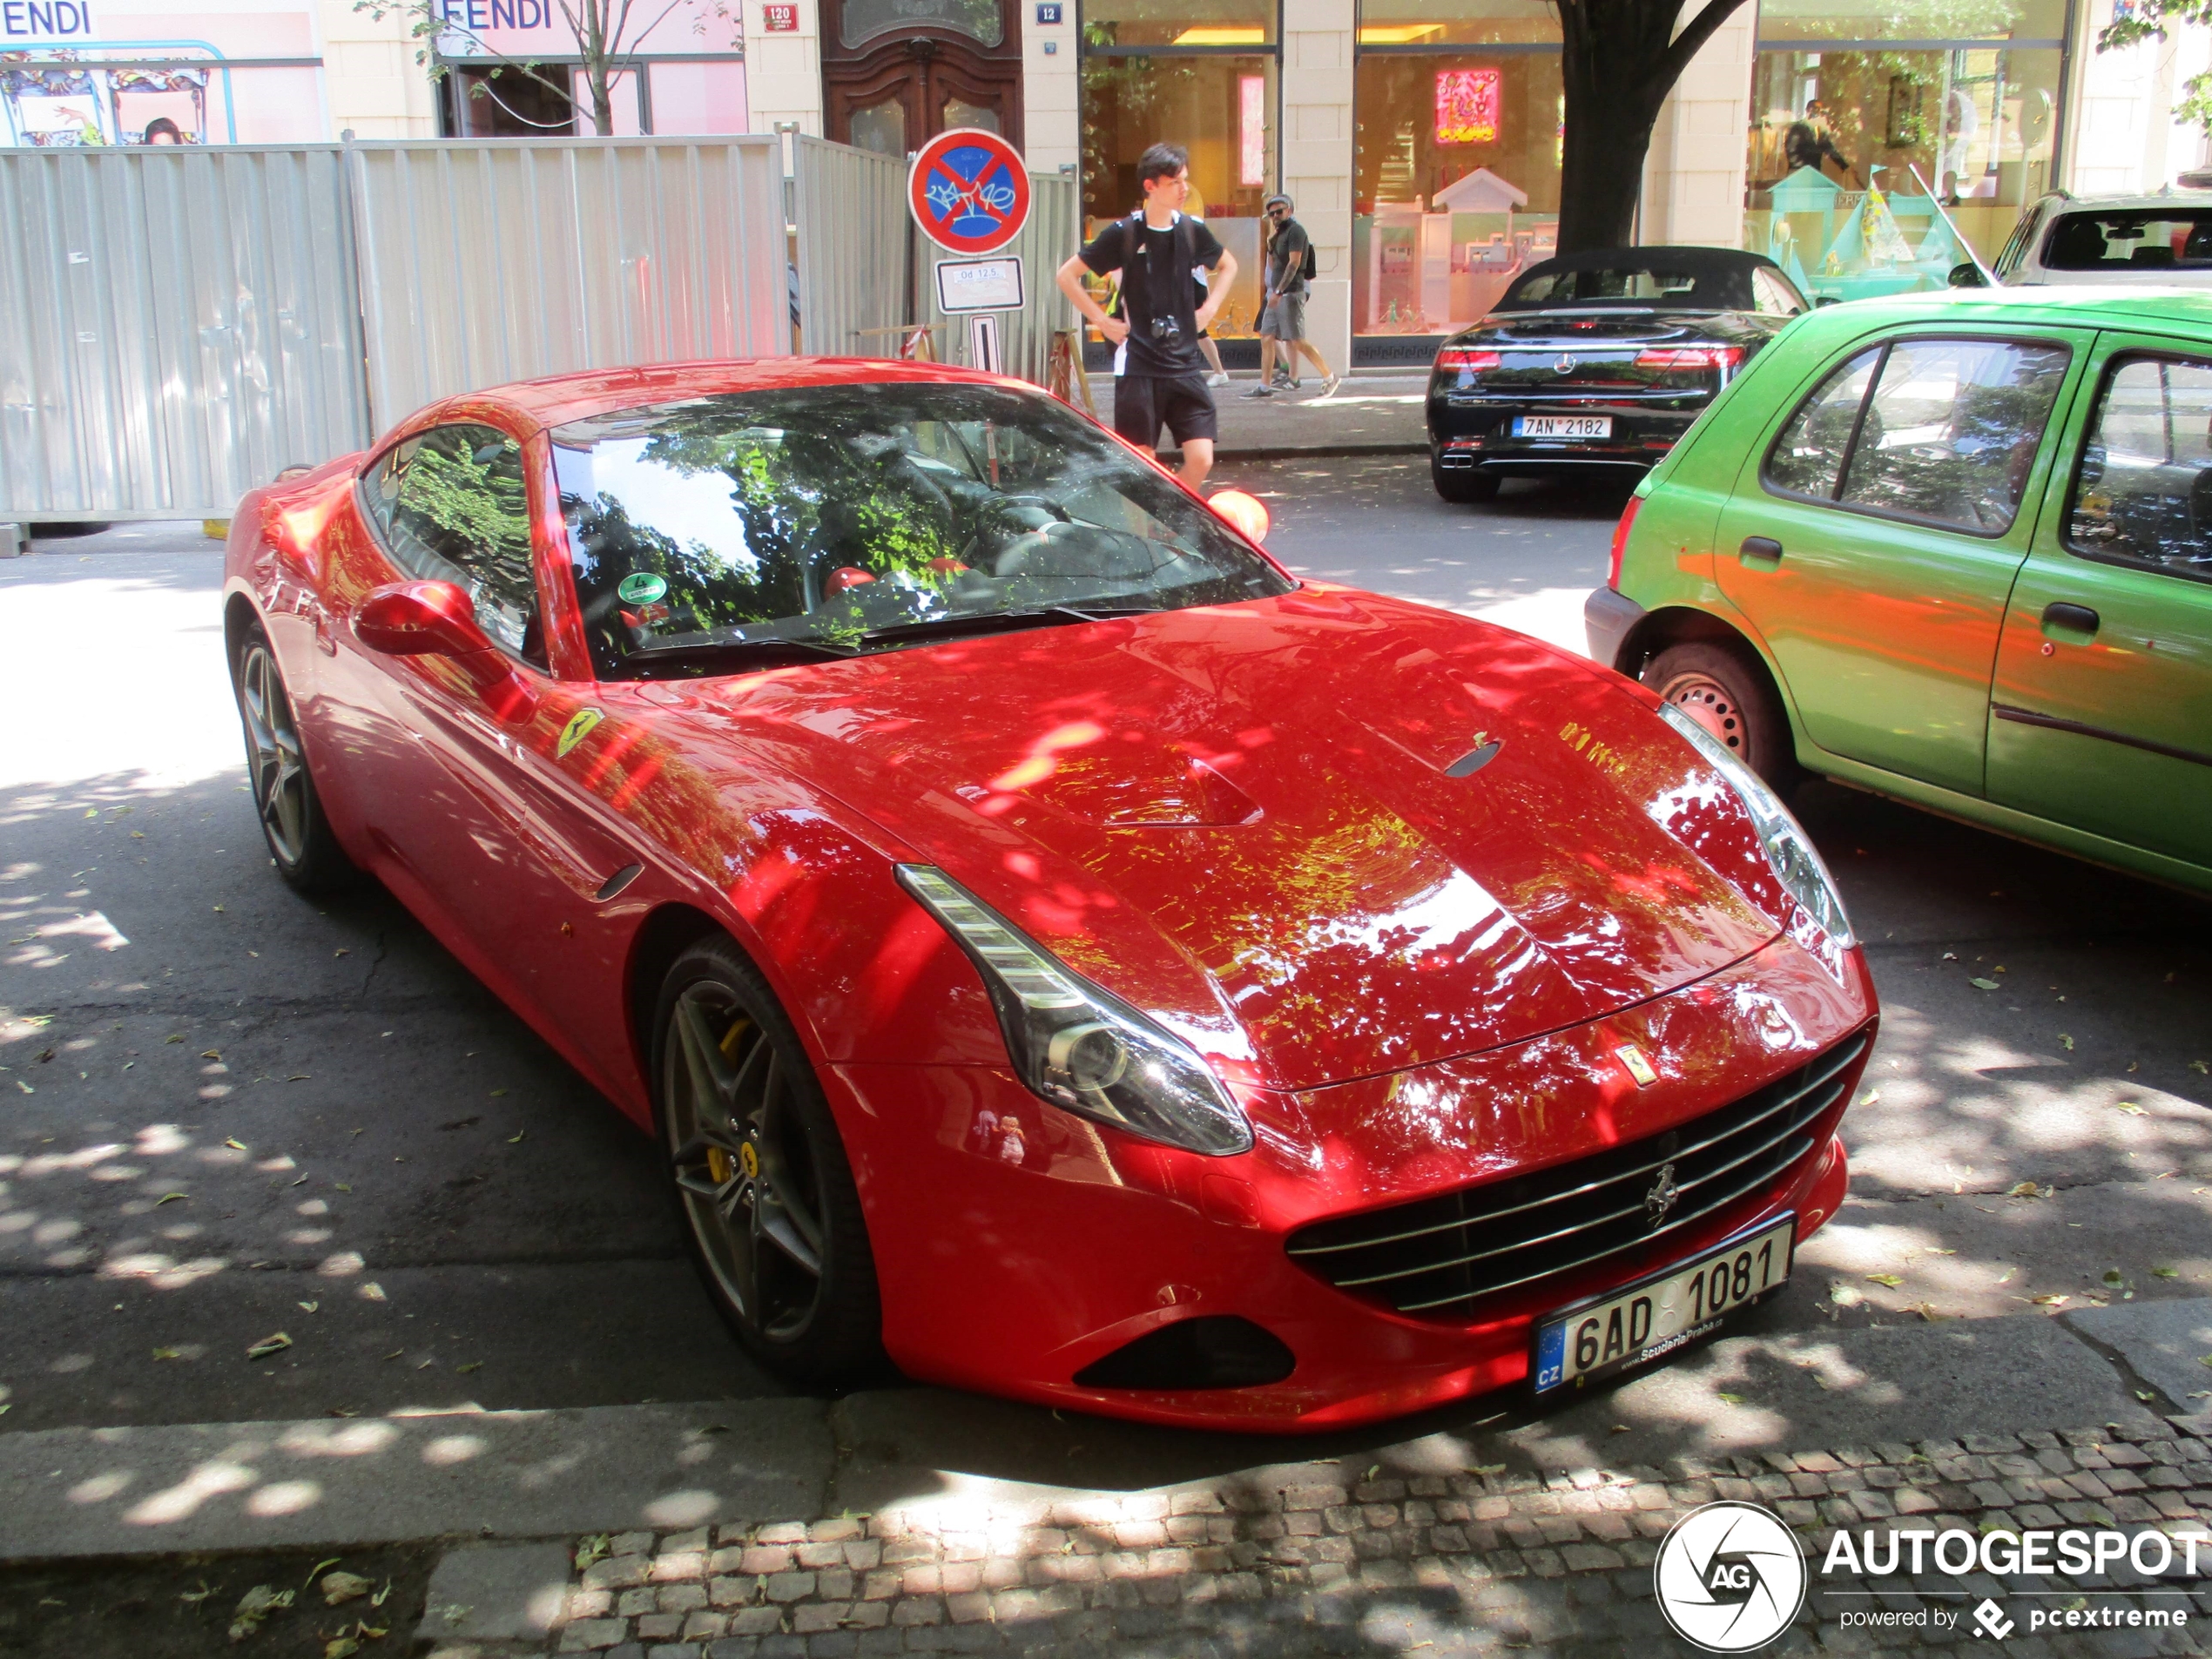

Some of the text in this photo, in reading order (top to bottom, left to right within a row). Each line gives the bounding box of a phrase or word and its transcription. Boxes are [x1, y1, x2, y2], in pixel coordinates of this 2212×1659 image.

[442, 0, 551, 30] FENDI
[771, 7, 790, 19] 120
[1043, 8, 1055, 20] 12
[1527, 419, 1603, 435] 7AN 2182
[1575, 1238, 1772, 1371] 6AD 1081
[1538, 1365, 1560, 1386] CZ
